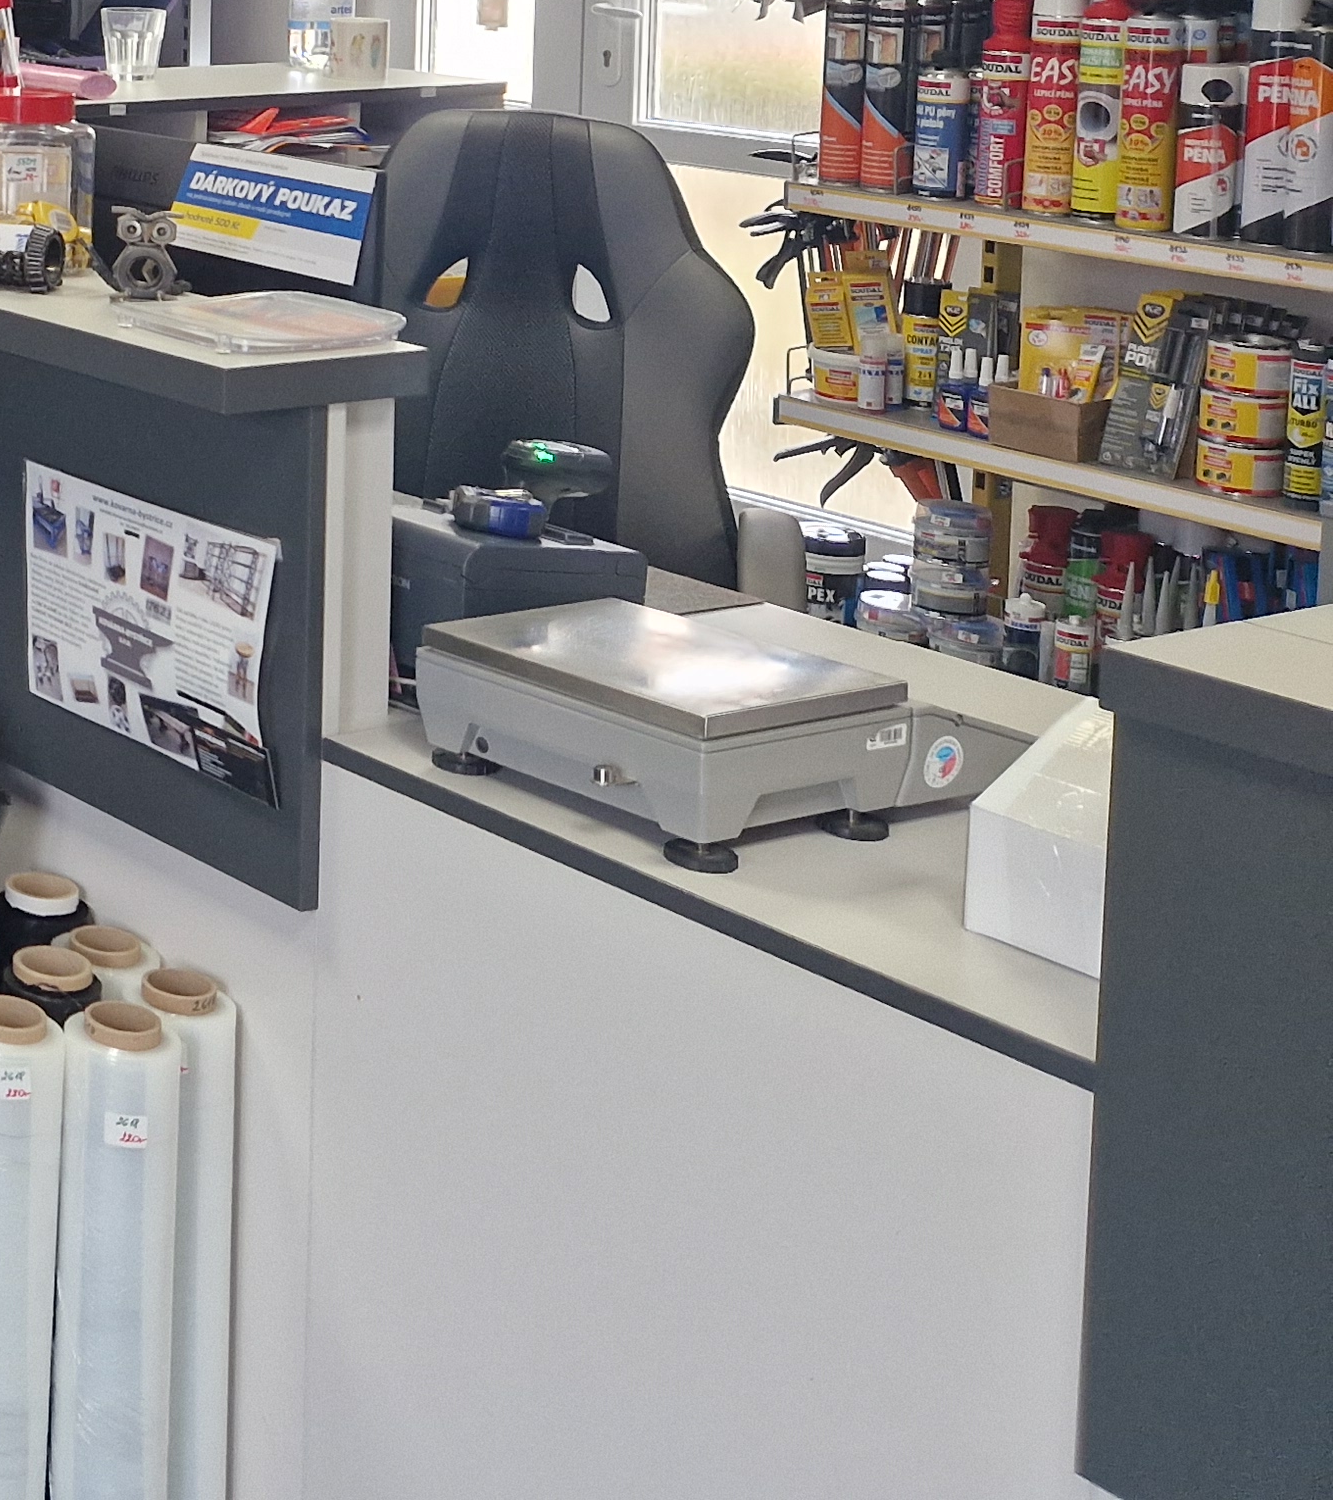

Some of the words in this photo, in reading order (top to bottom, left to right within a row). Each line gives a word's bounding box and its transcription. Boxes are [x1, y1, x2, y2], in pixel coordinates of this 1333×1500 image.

[1036, 27, 1080, 37] SOUDAL
[987, 135, 1005, 198] COMFORT
[189, 170, 275, 203] DÁRKOVÝ
[274, 187, 358, 221] POUKAZ
[215, 217, 231, 228] 500
[1292, 394, 1318, 411] ALL
